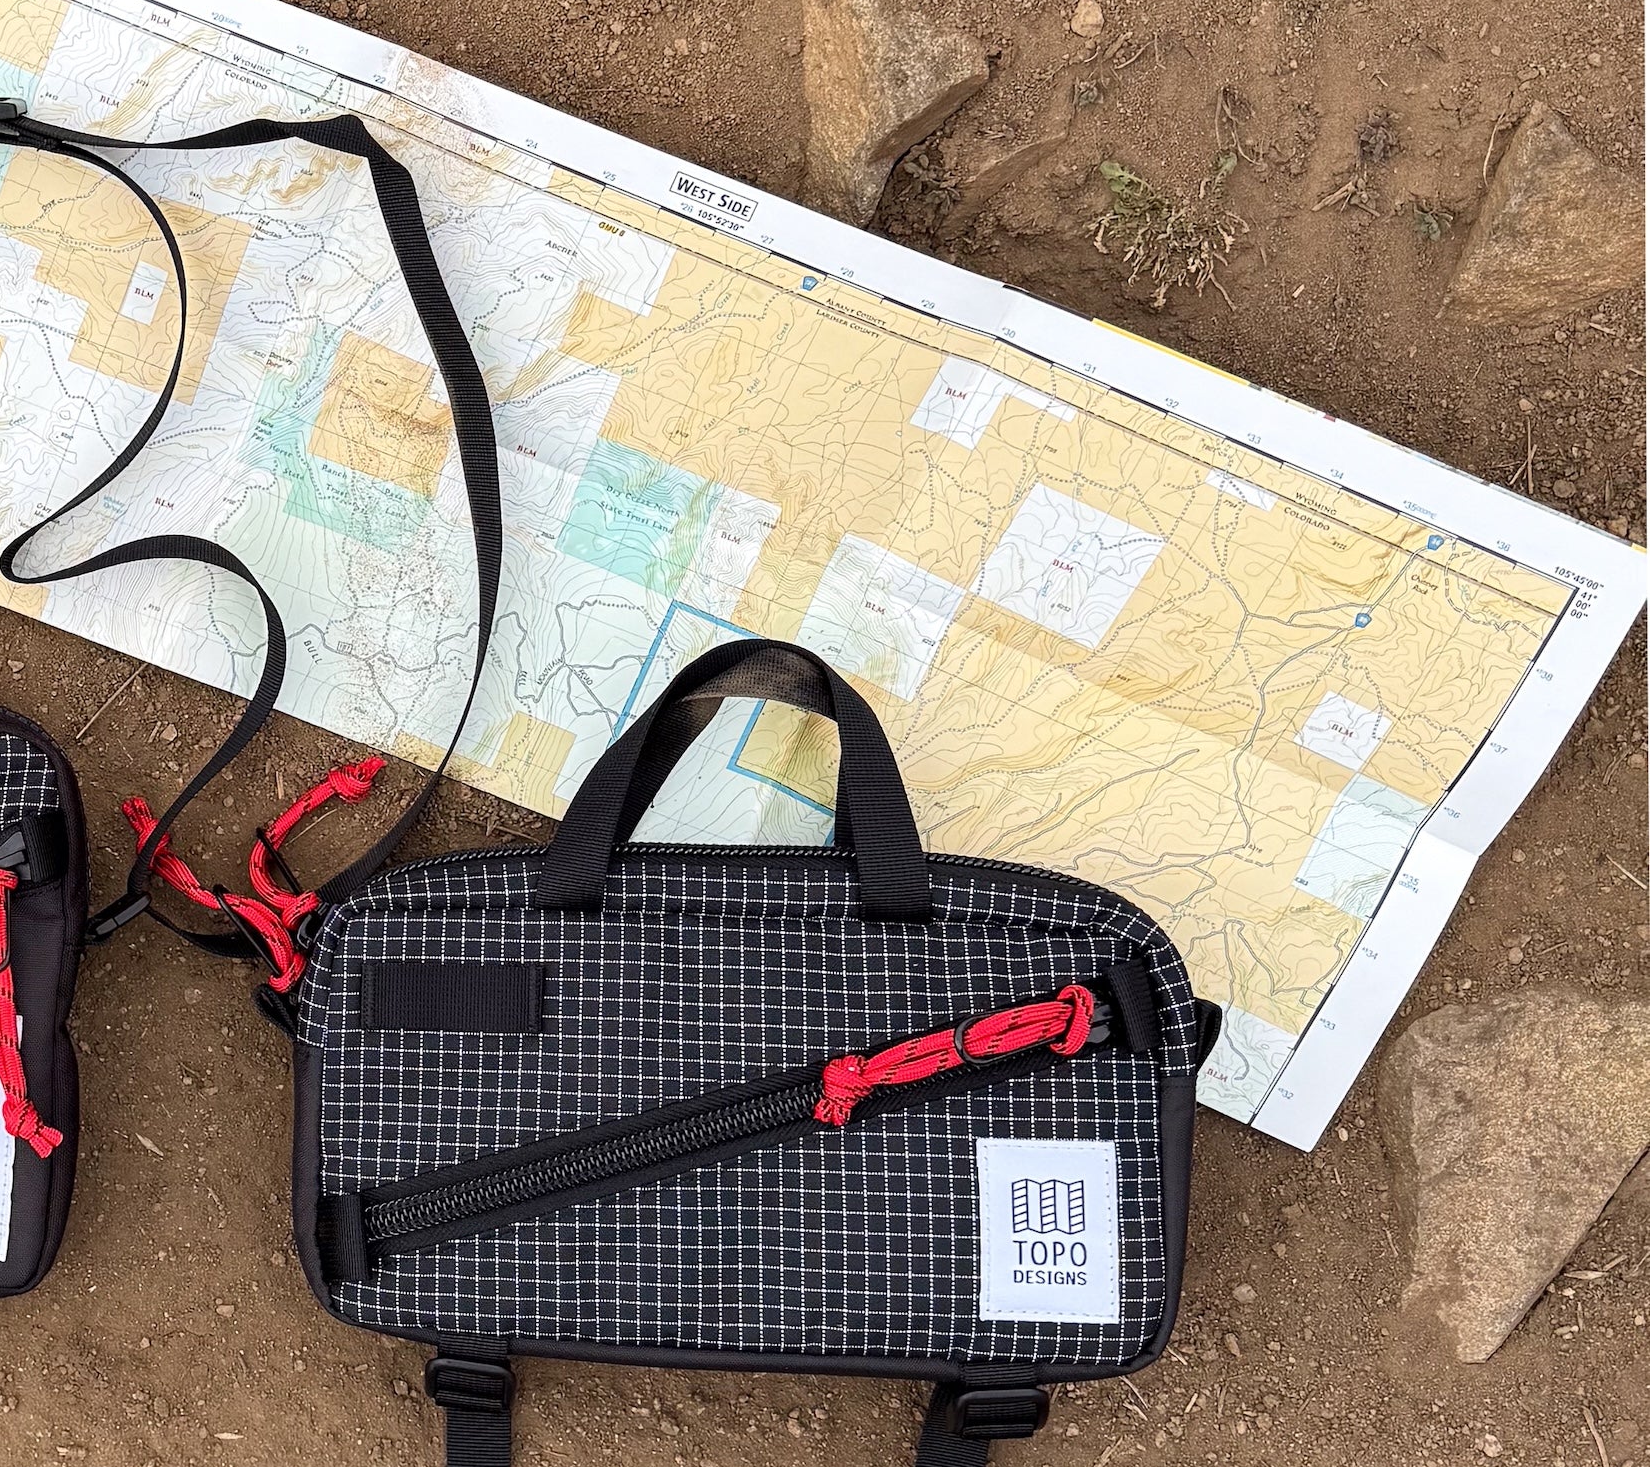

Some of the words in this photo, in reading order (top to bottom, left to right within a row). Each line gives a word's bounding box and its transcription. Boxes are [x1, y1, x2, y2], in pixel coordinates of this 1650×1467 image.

[231, 54, 272, 75] WYOMING
[224, 68, 268, 91] COLORADO
[675, 176, 716, 203] WEST
[717, 193, 752, 217] SIDE
[134, 287, 155, 300] BLM
[945, 386, 967, 401] BLM
[1293, 492, 1338, 515] WYOMING
[1283, 506, 1331, 531] COLORADO
[720, 531, 741, 545] BLM
[1051, 559, 1074, 573] BLM
[864, 601, 885, 615] BLM
[1013, 1240, 1088, 1267] TOPO
[1013, 1270, 1088, 1286] DESIGNS
